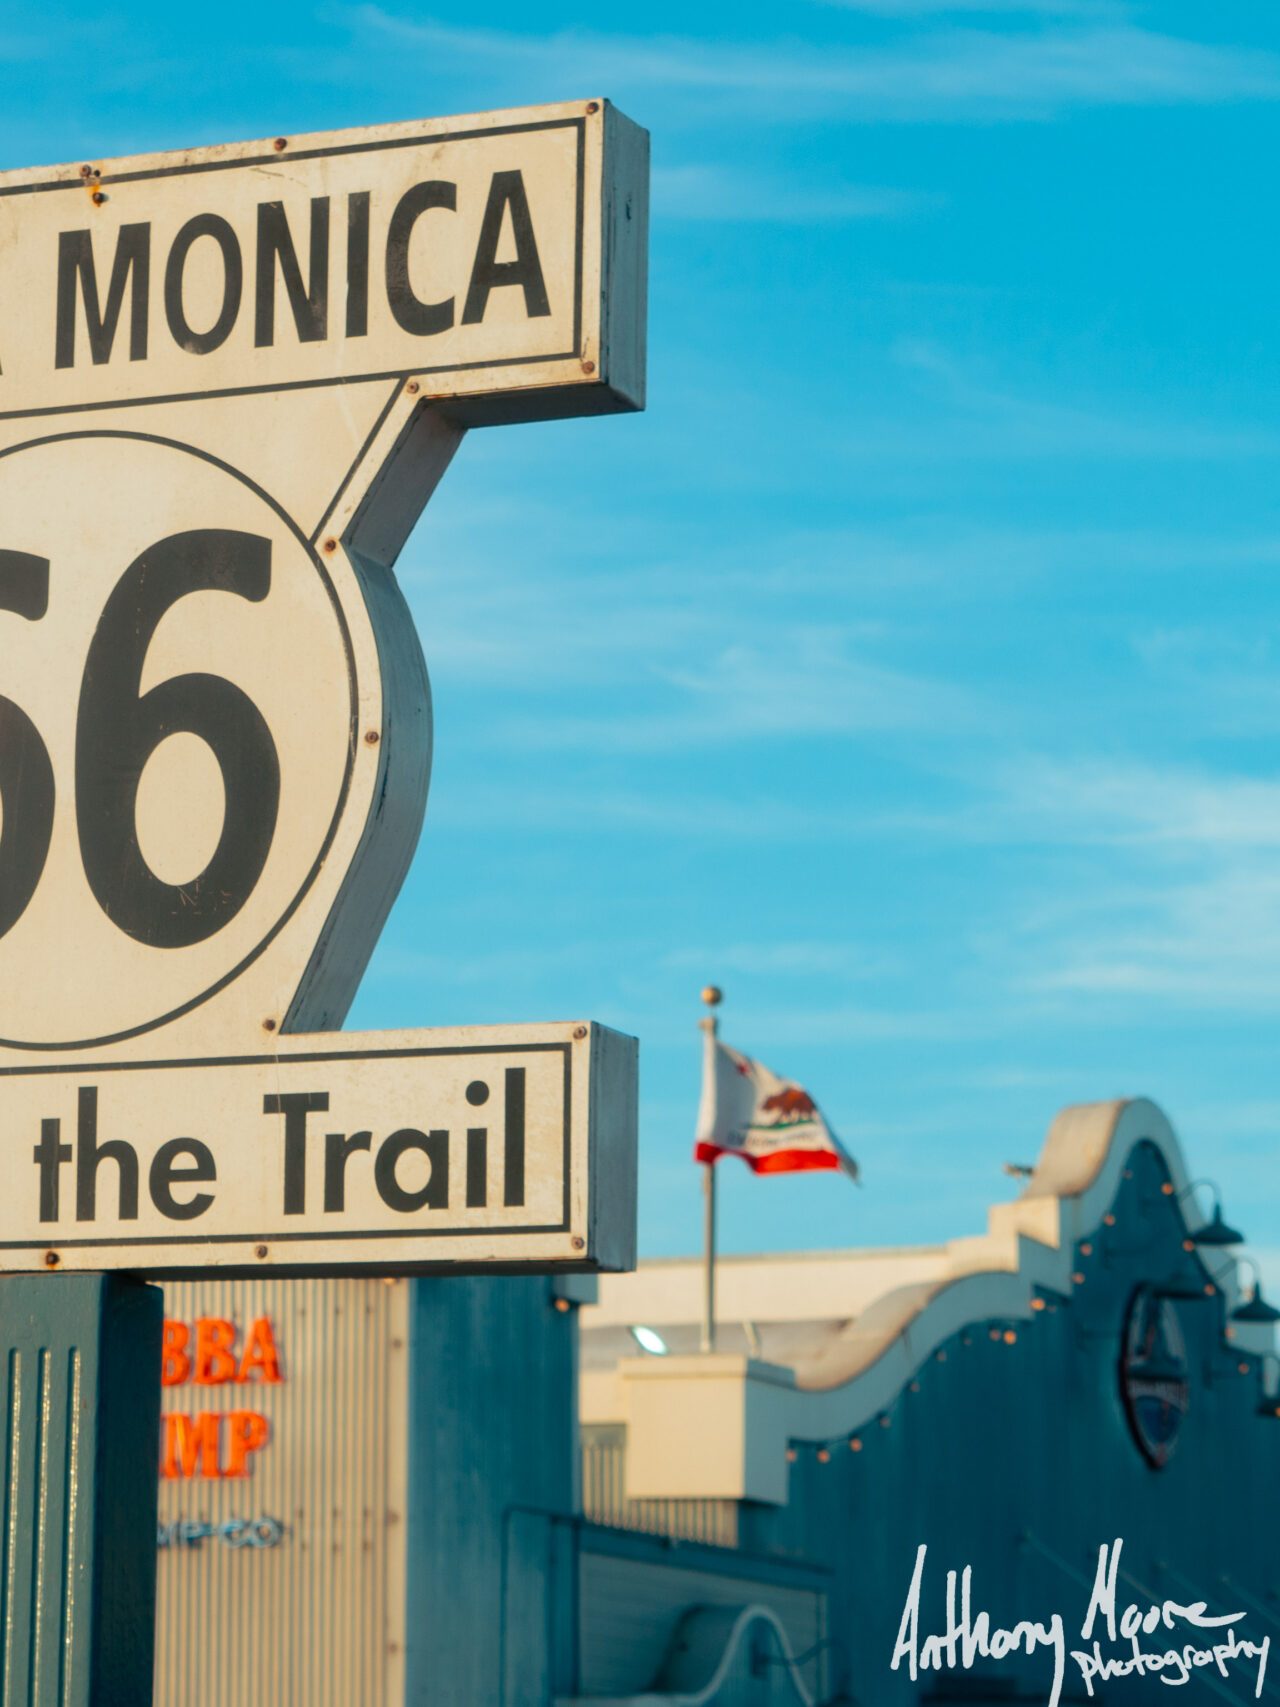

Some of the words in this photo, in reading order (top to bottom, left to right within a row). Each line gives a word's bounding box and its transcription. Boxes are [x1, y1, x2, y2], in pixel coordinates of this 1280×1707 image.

[54, 168, 551, 369] MONICA
[33, 1085, 218, 1223] the
[262, 1067, 527, 1216] Trail
